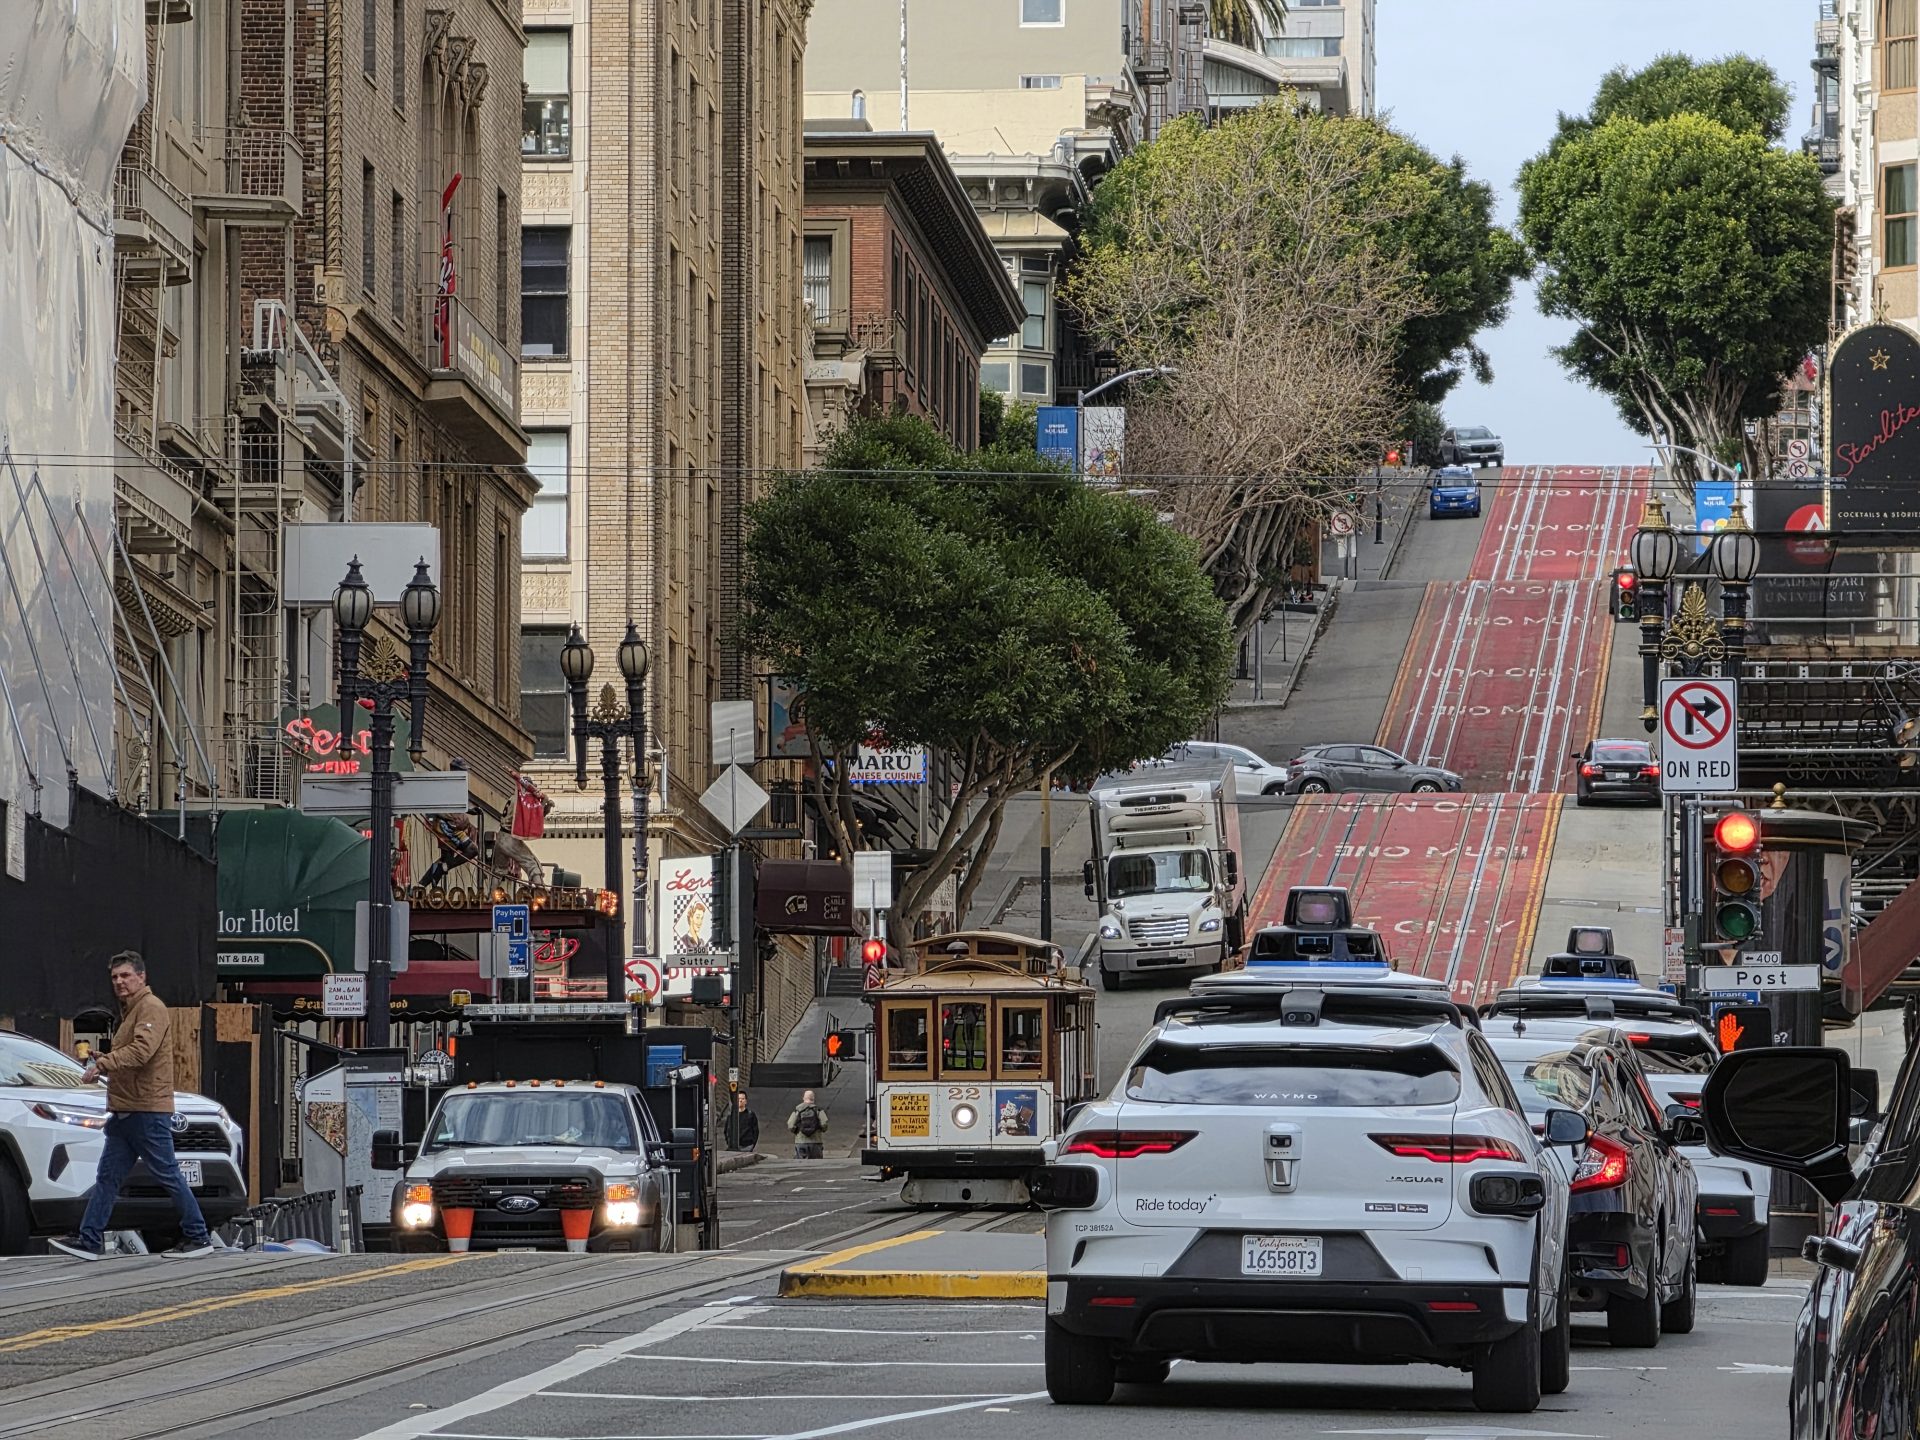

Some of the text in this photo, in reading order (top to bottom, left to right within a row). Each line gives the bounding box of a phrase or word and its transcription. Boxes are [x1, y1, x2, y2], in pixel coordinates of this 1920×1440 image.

[1837, 401, 1920, 477] Starlite
[1841, 577, 1864, 586] ART
[1667, 760, 1731, 779] ON RED
[1786, 762, 1880, 781] GRAND
[850, 771, 922, 780] ANESE CUISINE
[495, 910, 509, 918] Pay
[218, 908, 300, 933] lor Hotel
[680, 957, 715, 966] Sutter
[1756, 953, 1779, 963] 400
[1736, 970, 1787, 986] Post
[389, 999, 409, 1009] ood
[948, 1087, 981, 1100] 22
[1386, 1176, 1444, 1184] JAGUAR
[1136, 1198, 1207, 1214] Ride today
[1075, 1224, 1114, 1232] TCP 38152A
[1260, 1239, 1302, 1250] California
[1247, 1250, 1317, 1269] 16558T3
